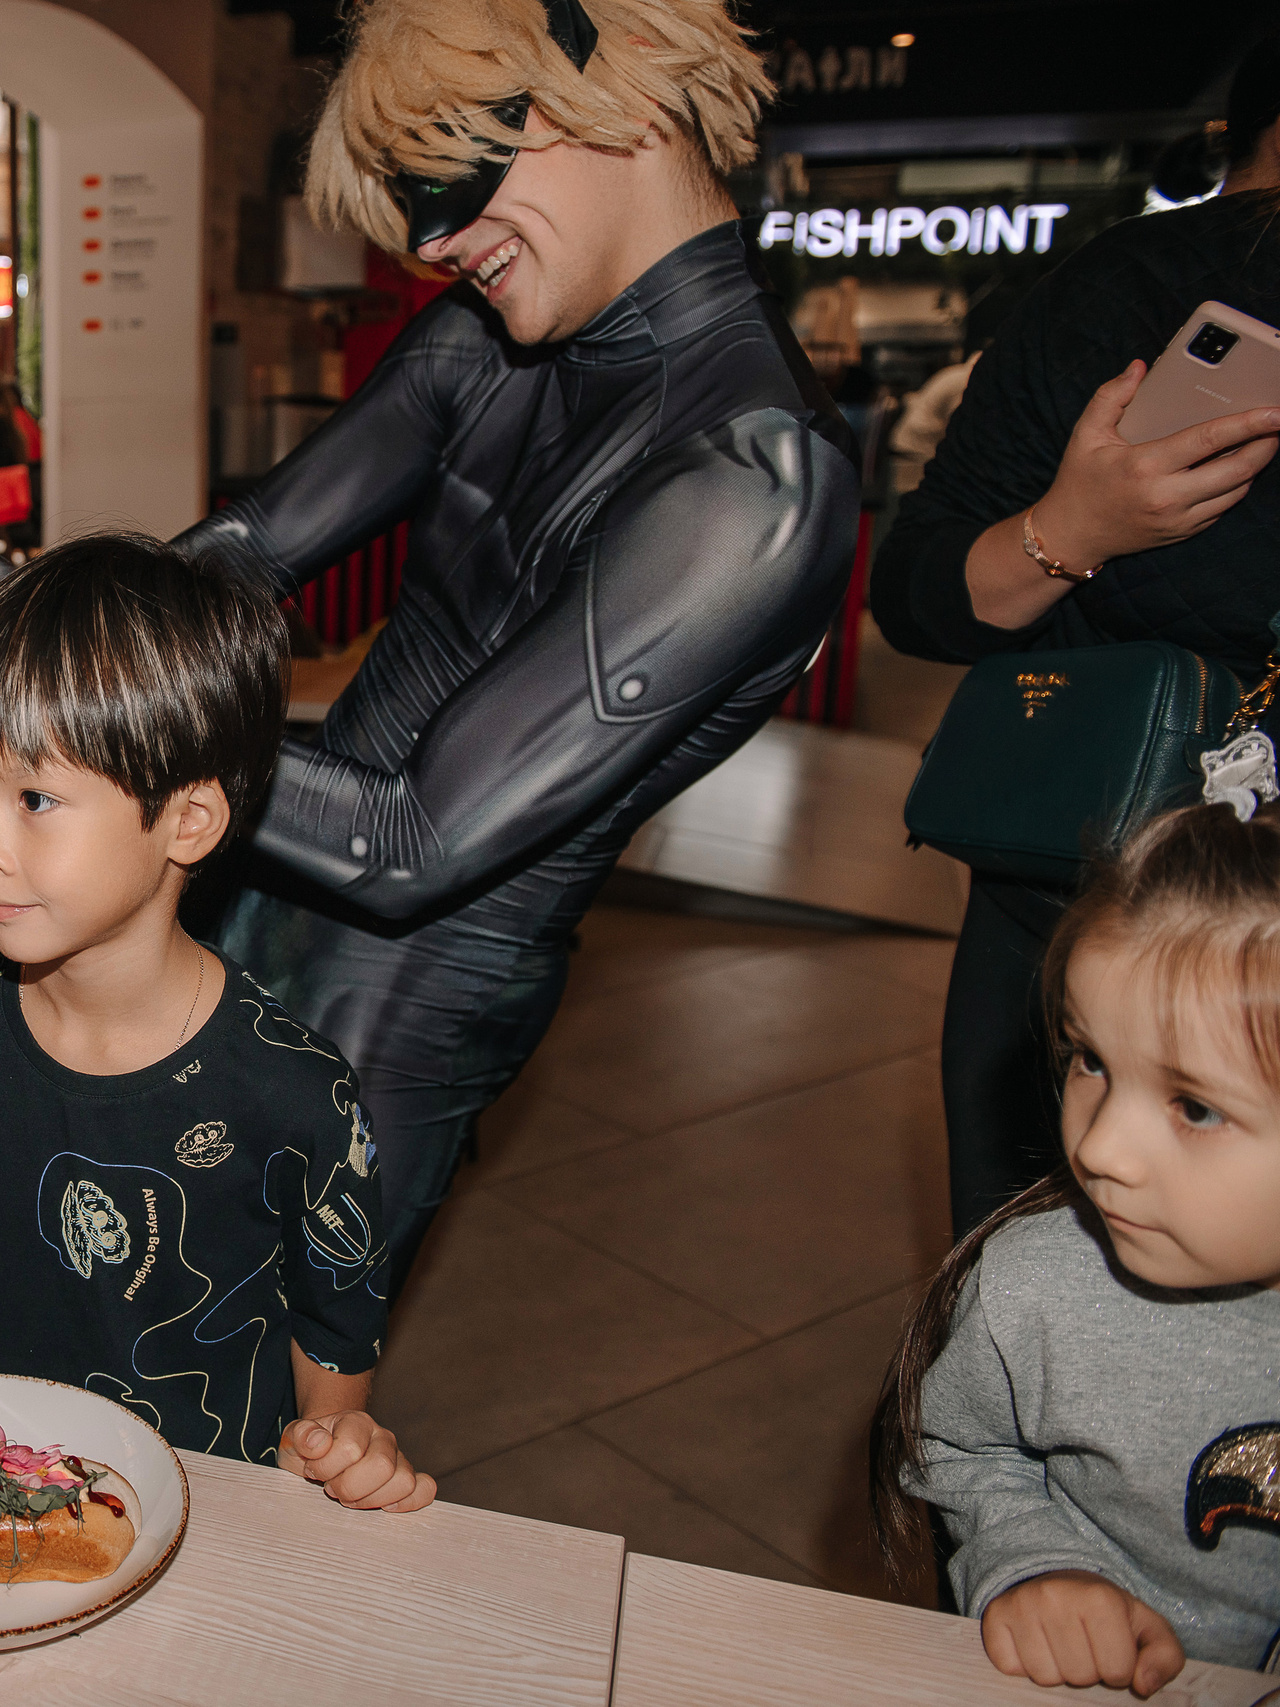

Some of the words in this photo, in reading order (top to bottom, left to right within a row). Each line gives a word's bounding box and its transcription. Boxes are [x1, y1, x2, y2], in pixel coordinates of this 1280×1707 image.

[759, 204, 1070, 258] FISHPOINT
[142, 1188, 158, 1234] Always
[147, 1236, 160, 1252] Be
[123, 1254, 156, 1302] Original
